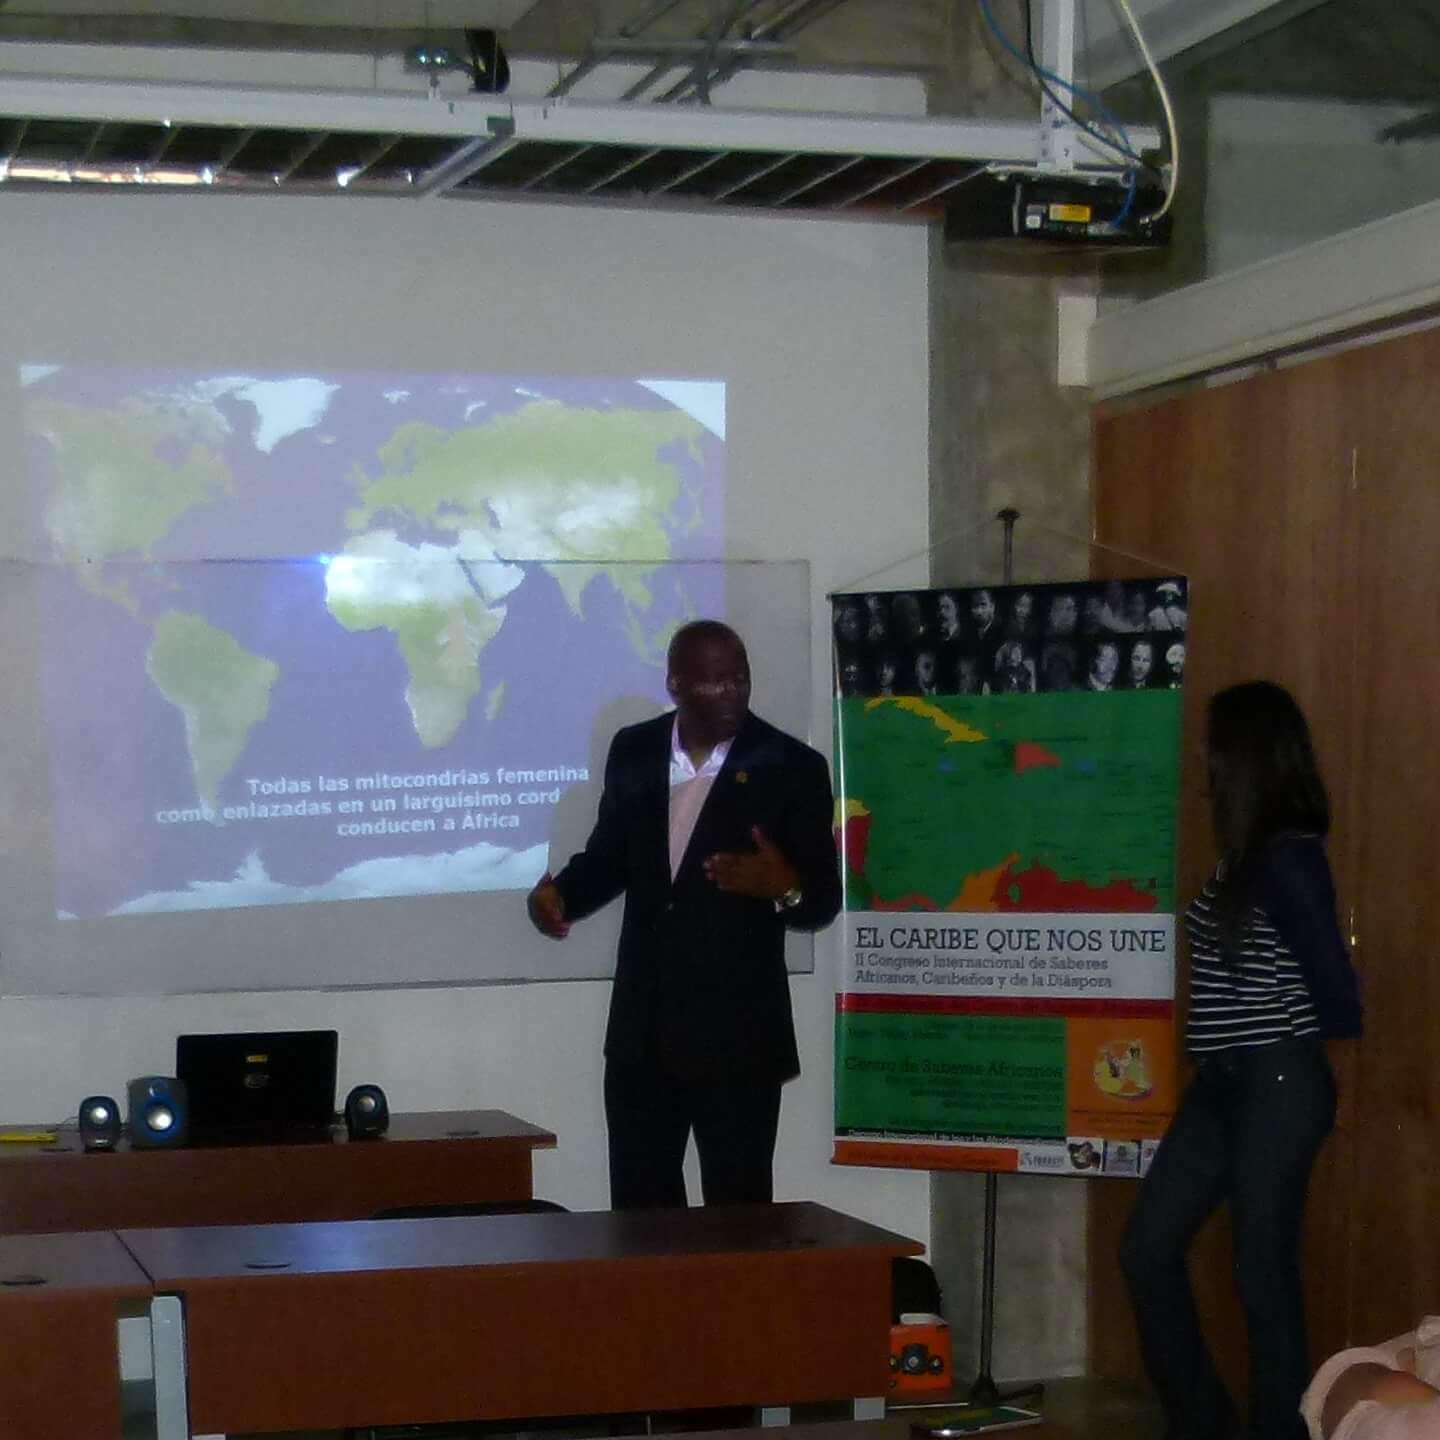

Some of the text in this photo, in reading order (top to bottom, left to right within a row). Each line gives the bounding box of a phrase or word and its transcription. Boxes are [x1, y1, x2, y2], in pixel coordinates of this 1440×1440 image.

[245, 776, 312, 796] Todas
[318, 775, 350, 792] las
[354, 768, 491, 791] mitocondrias
[155, 807, 216, 824] como
[223, 800, 333, 820] enlazadas
[338, 800, 364, 813] en
[371, 798, 397, 812] un
[336, 816, 436, 837] conducen
[442, 818, 455, 832] a
[855, 927, 1167, 953] EL CARIBE QUE NOS UNE
[854, 952, 1108, 970] II Congreso Internacional de Saberes
[854, 969, 1112, 991] Africanos, Caribeños y de la Diáspora
